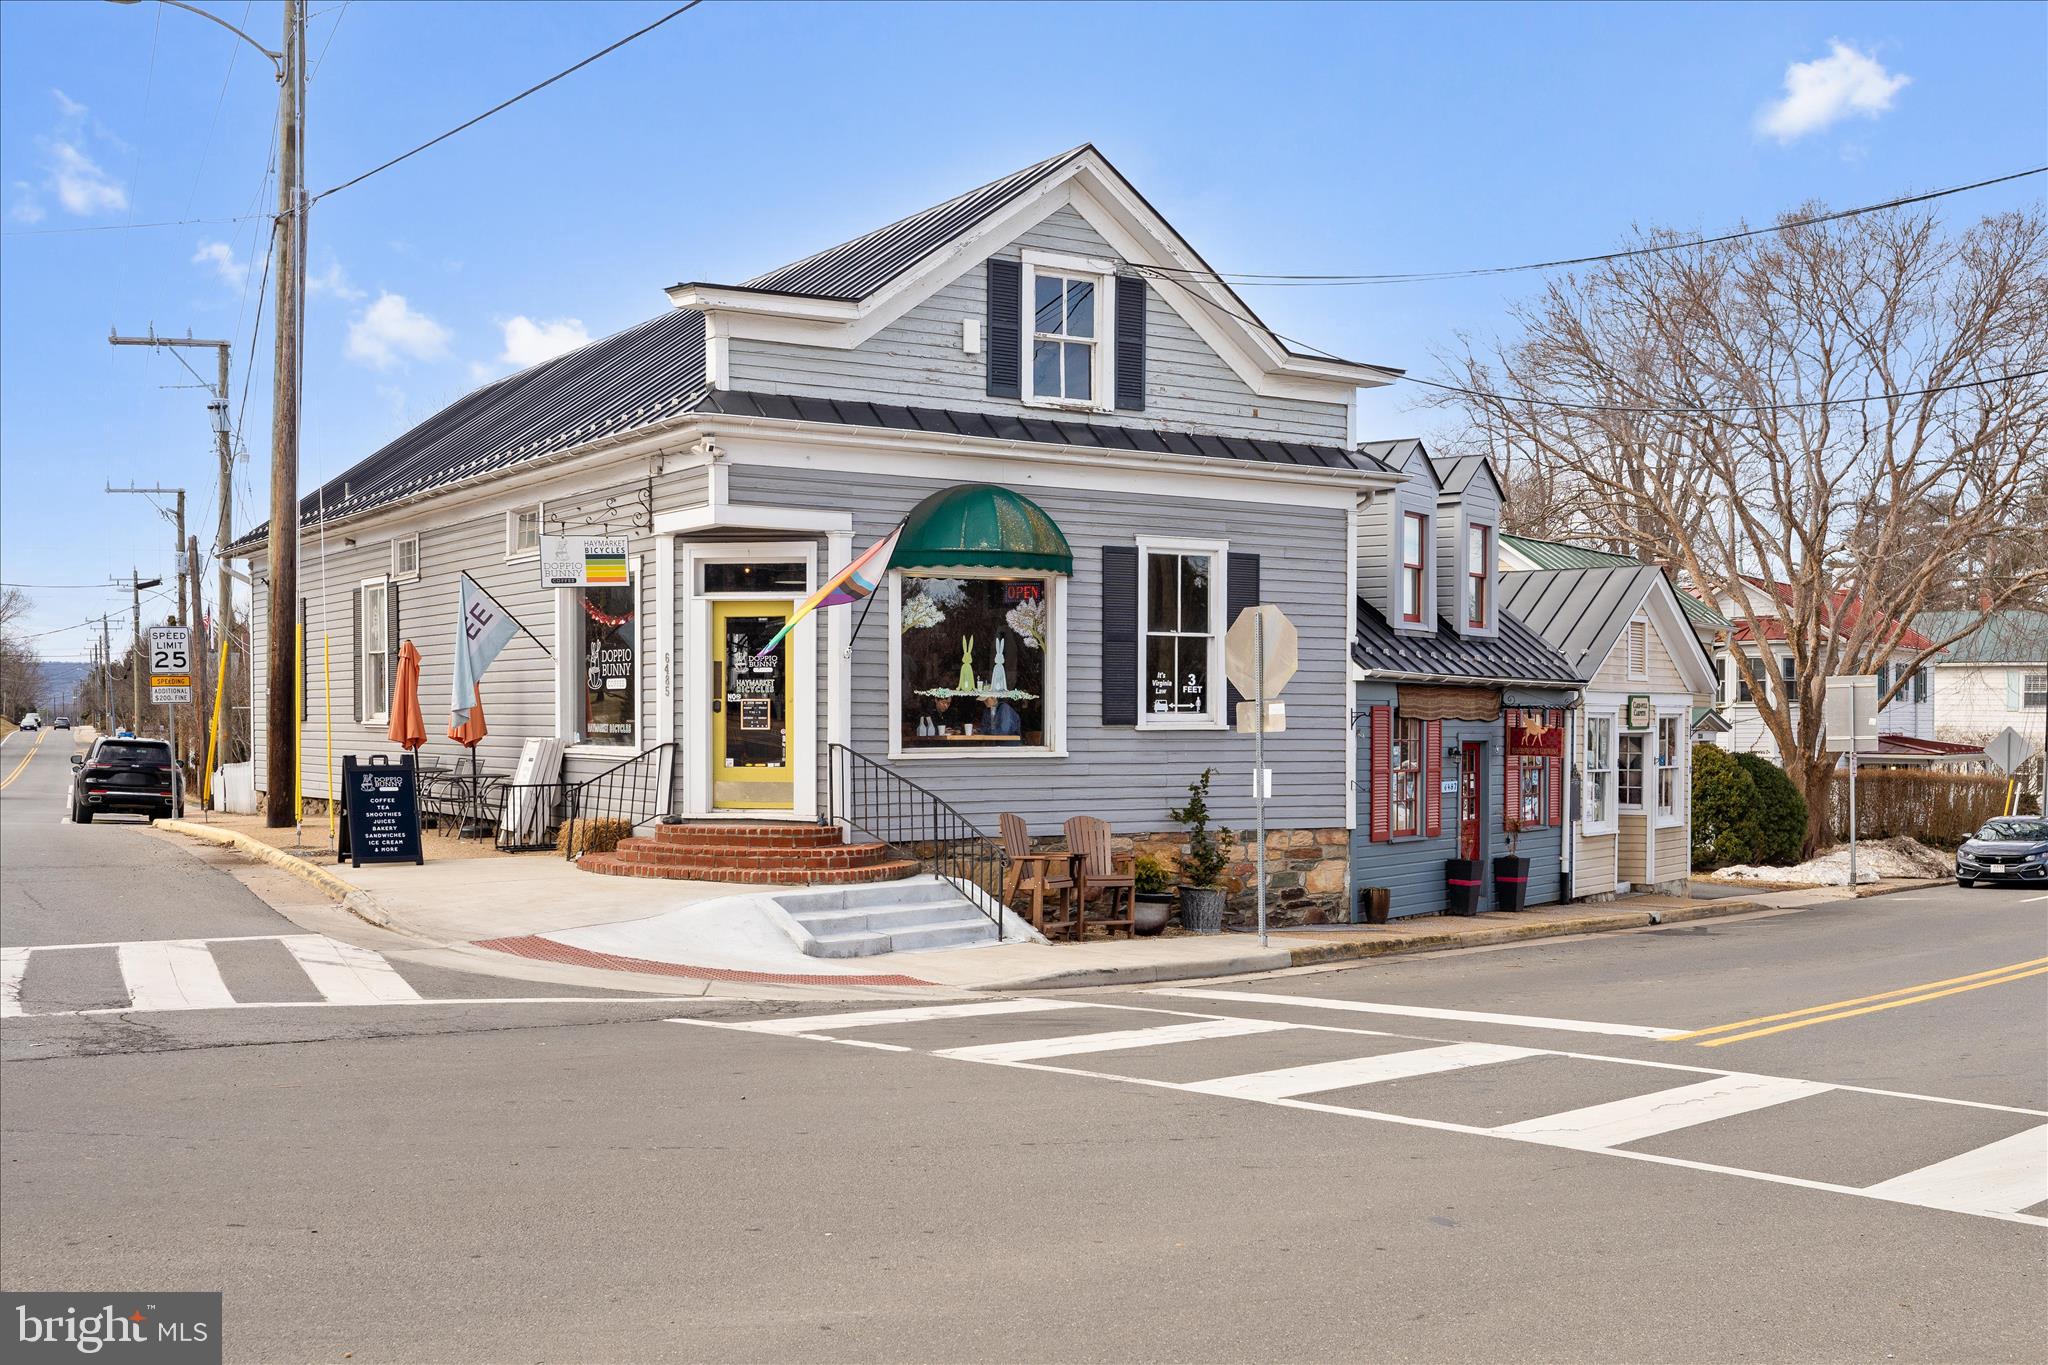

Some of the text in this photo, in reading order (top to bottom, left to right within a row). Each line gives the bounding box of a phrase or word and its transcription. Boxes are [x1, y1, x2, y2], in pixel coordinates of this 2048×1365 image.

[543, 562, 582, 570] DOPPIO
[1008, 585, 1038, 599] OPEN
[152, 632, 186, 640] SPEED
[154, 651, 187, 668] 25
[601, 648, 632, 662] DOPPIO
[602, 663, 632, 676] BUNNY
[1187, 673, 1196, 686] 3
